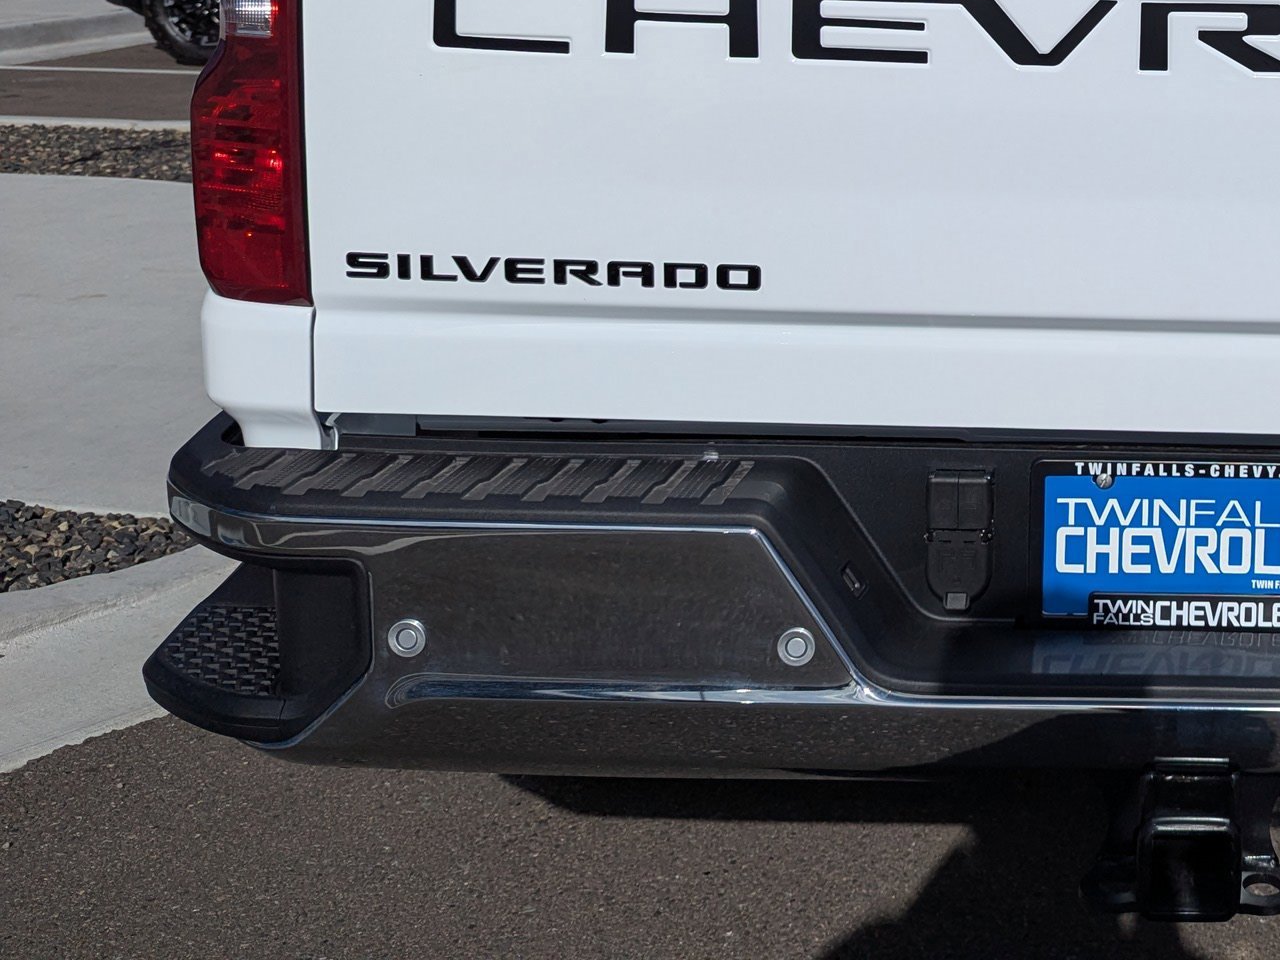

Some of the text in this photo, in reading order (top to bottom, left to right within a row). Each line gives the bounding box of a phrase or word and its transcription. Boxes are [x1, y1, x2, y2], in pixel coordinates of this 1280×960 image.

[346, 251, 762, 291] SILVERADO
[1251, 579, 1274, 590] TWIN
[1093, 599, 1153, 614] TWIN
[1093, 612, 1153, 626] FALLS
